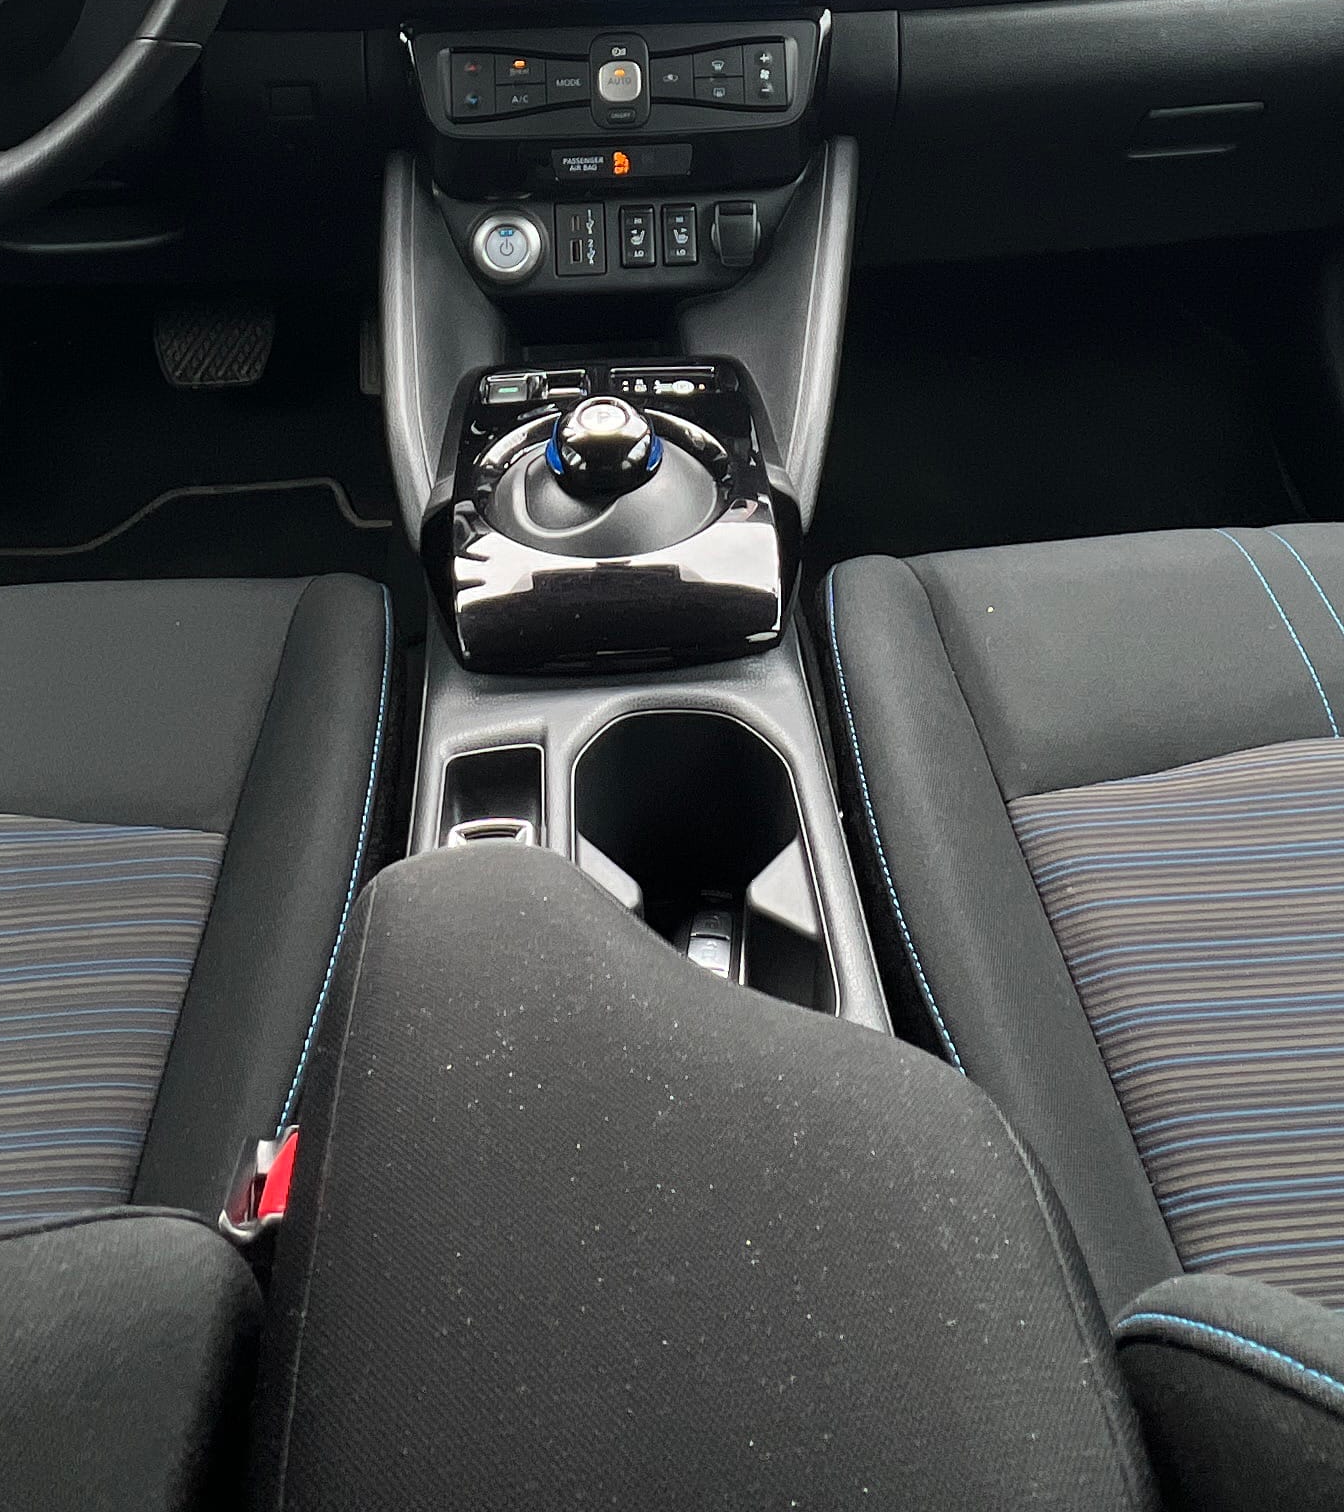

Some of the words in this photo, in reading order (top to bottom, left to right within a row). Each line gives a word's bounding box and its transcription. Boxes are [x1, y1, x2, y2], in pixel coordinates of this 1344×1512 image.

[555, 78, 582, 88] MODE
[607, 77, 632, 86] AUTO
[511, 94, 529, 104] A/C
[562, 156, 604, 165] PASSENGER
